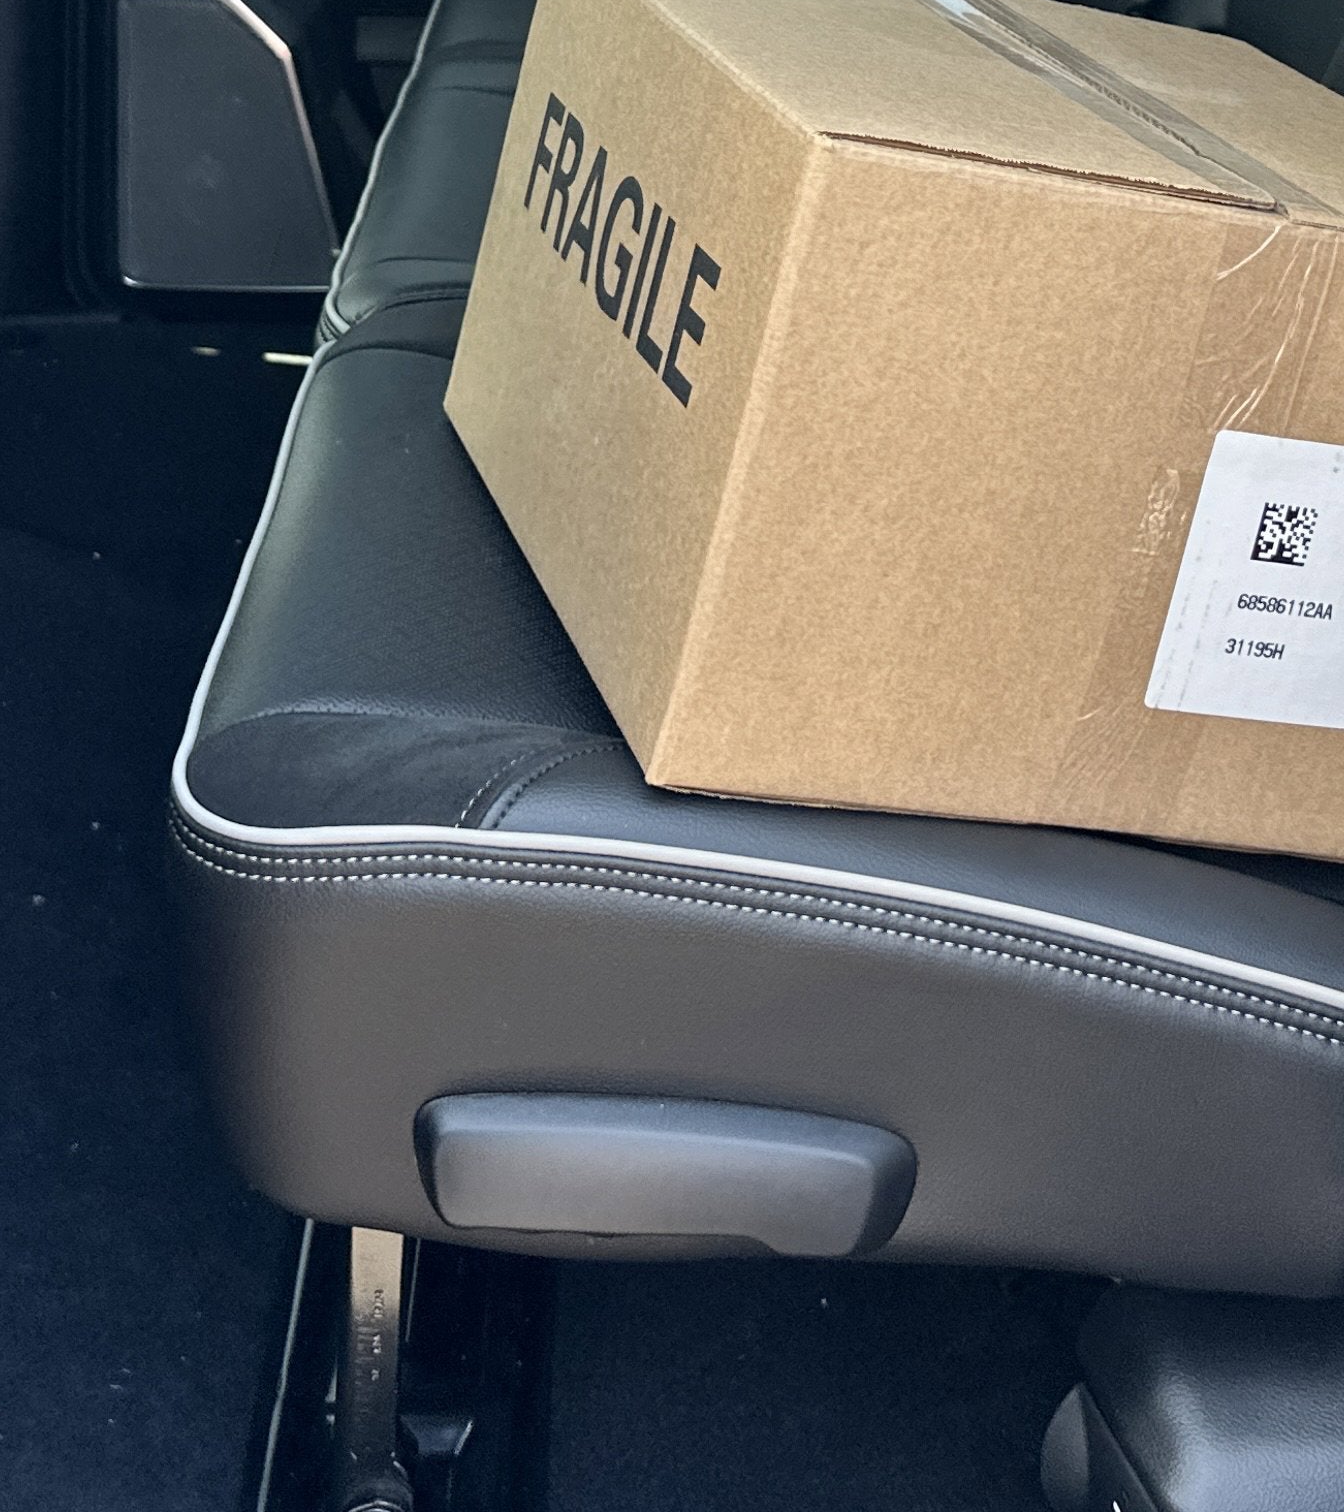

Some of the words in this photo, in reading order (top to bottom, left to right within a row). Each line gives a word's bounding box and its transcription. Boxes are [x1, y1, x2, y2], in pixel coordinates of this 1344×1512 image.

[523, 91, 722, 409] FRAGILE
[1237, 593, 1333, 621] 68586112AA
[1224, 637, 1286, 661] 31195H
